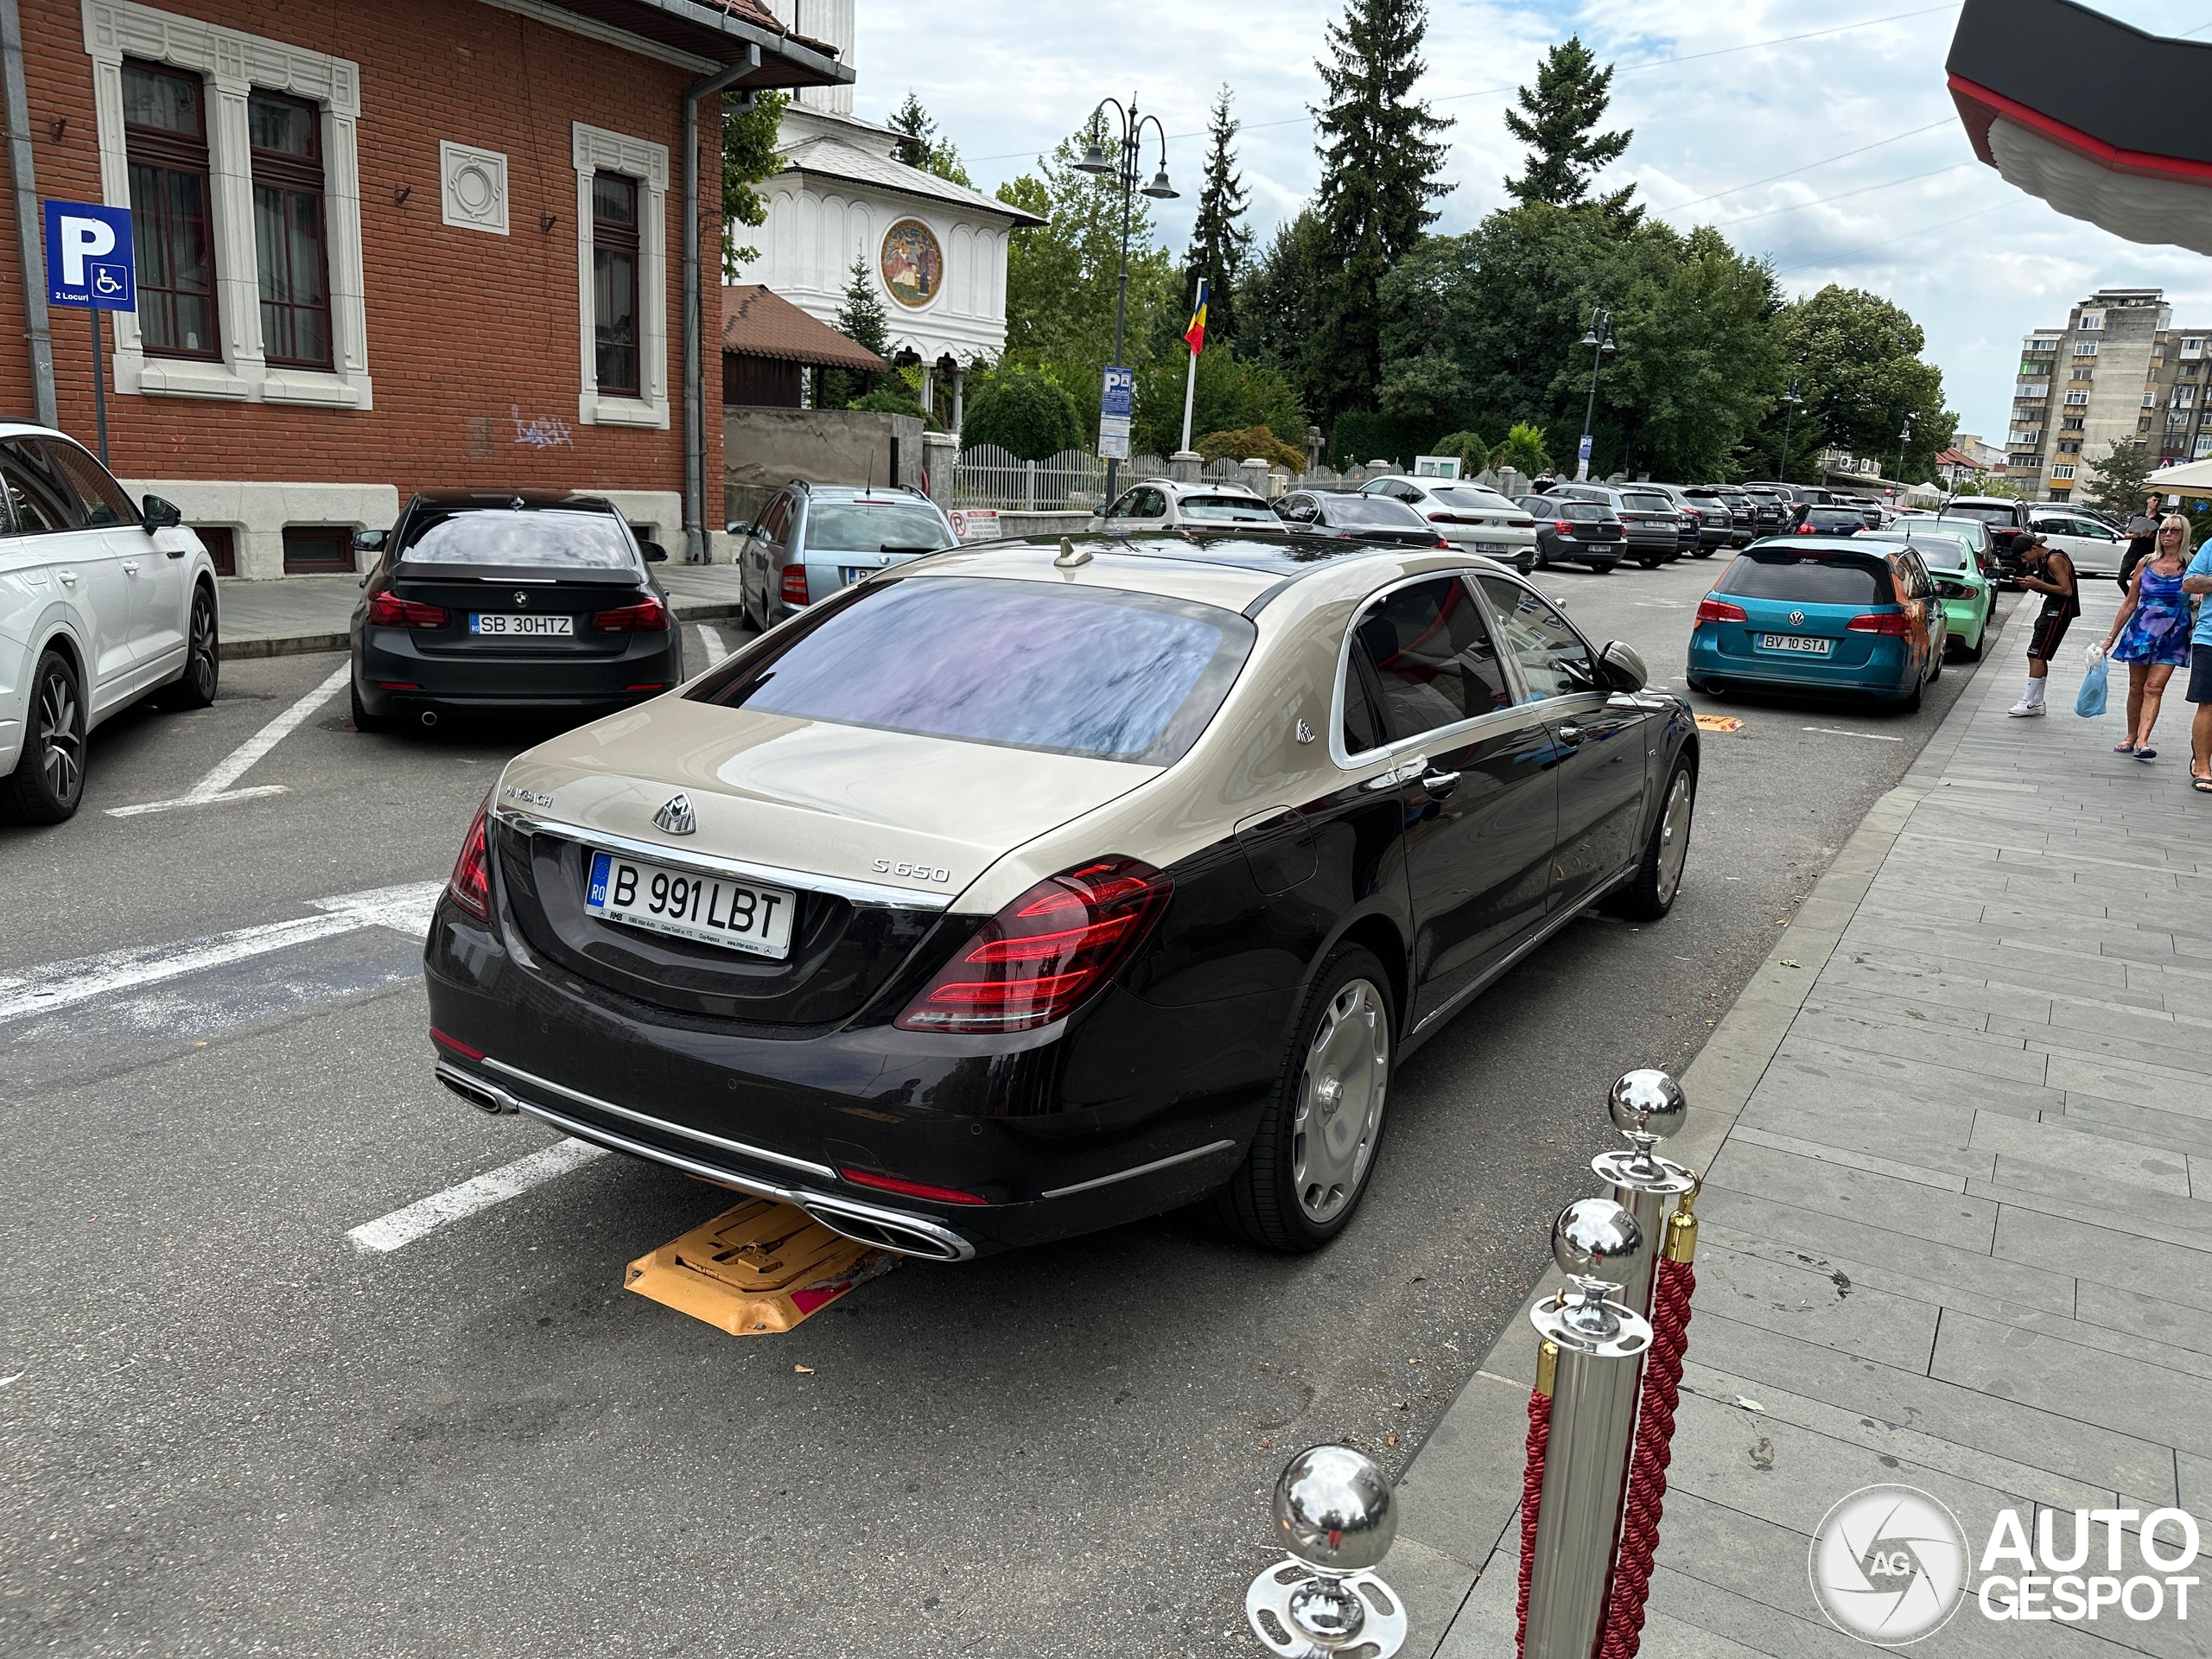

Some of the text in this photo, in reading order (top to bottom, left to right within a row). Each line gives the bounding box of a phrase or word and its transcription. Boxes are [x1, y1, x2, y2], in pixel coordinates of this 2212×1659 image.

[60, 216, 115, 285] P
[62, 292, 88, 302] Locuri
[1105, 373, 1121, 392] P
[481, 617, 506, 632] SB
[1765, 636, 1783, 647] BV
[1788, 638, 1799, 649] 10
[1802, 639, 1825, 652] STA
[872, 858, 950, 882] S 650
[591, 883, 606, 902] RO
[613, 864, 639, 906] B
[609, 911, 623, 921] RMB
[698, 932, 720, 943] Cluj-Napoca
[727, 939, 759, 951] www.inter-auto.ro
